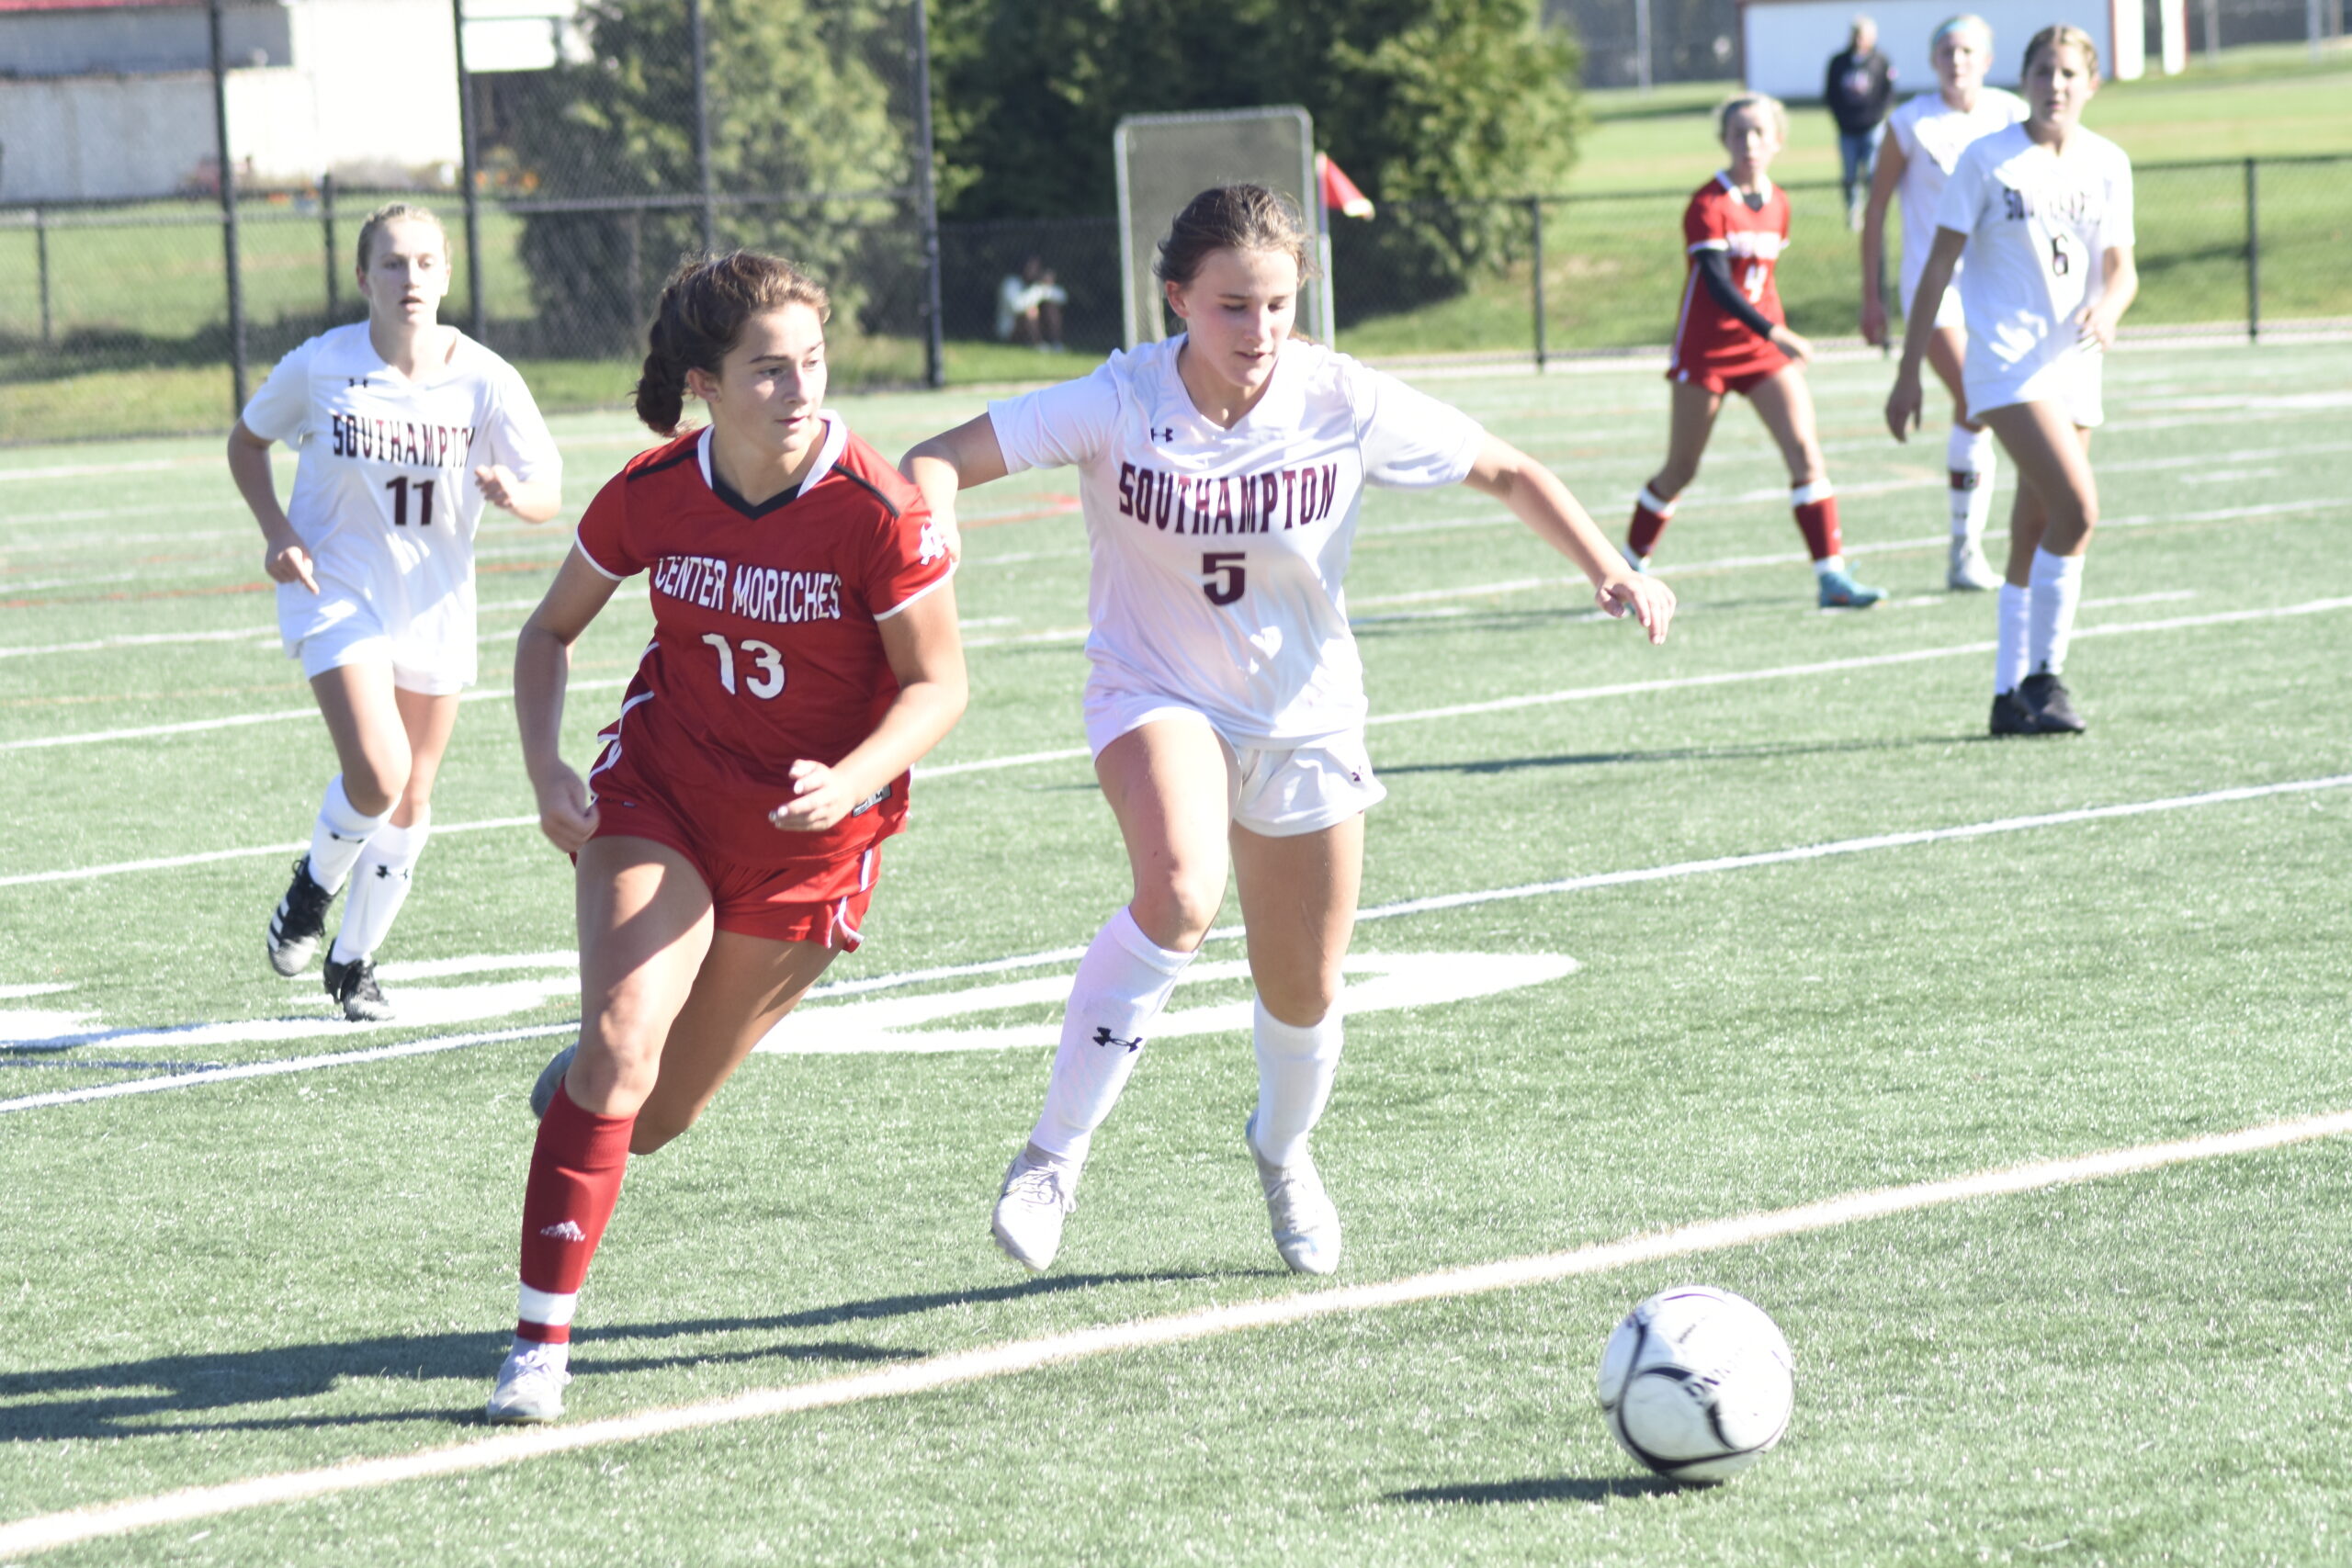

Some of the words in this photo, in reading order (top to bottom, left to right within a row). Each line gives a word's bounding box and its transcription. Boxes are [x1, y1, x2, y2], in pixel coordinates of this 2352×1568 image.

[2052, 233, 2068, 276] 6
[385, 475, 435, 526] 11
[1119, 461, 1338, 535] SOUTHAMPTON
[654, 556, 727, 611] CENTER
[731, 564, 842, 623] MORICHES
[1202, 552, 1246, 606] 5
[701, 633, 786, 699] 13
